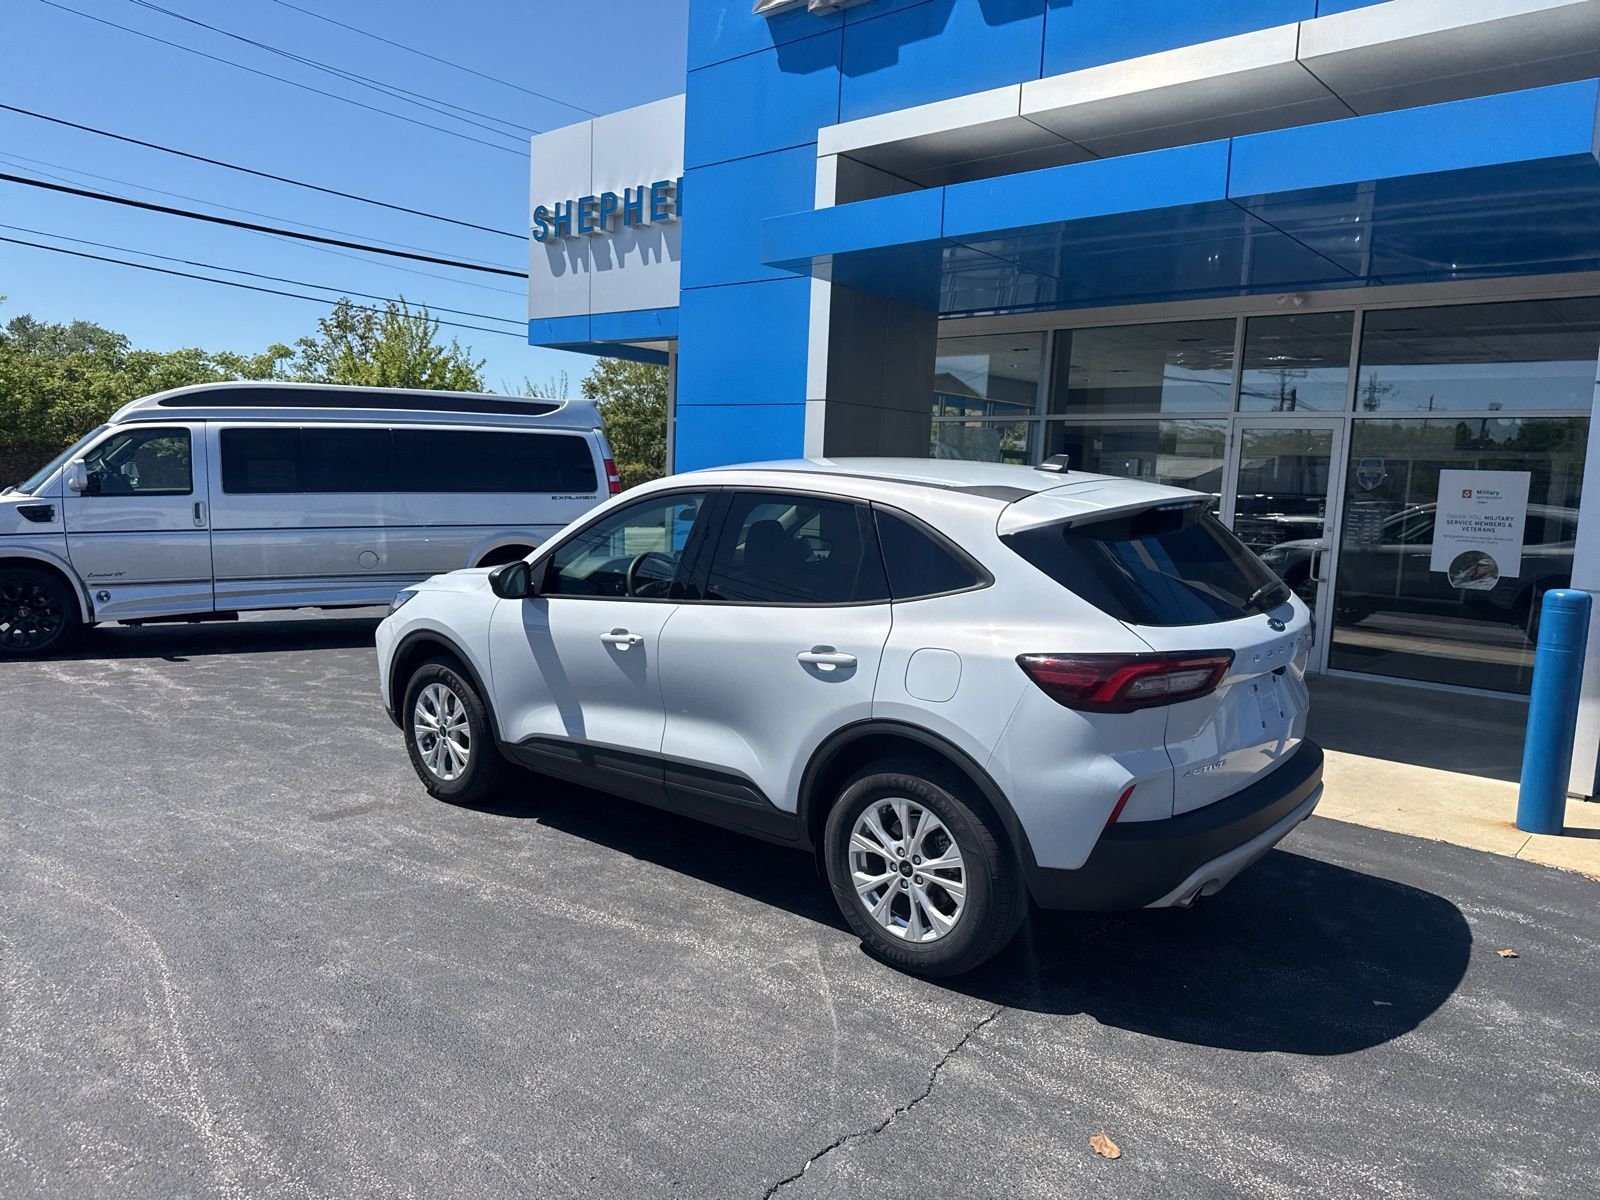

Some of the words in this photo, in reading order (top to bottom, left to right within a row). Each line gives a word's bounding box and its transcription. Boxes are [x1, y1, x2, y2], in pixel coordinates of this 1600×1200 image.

[532, 176, 683, 243] SHEPHE
[1446, 519, 1473, 527] SERVICE
[1474, 520, 1506, 528] MEMBERS
